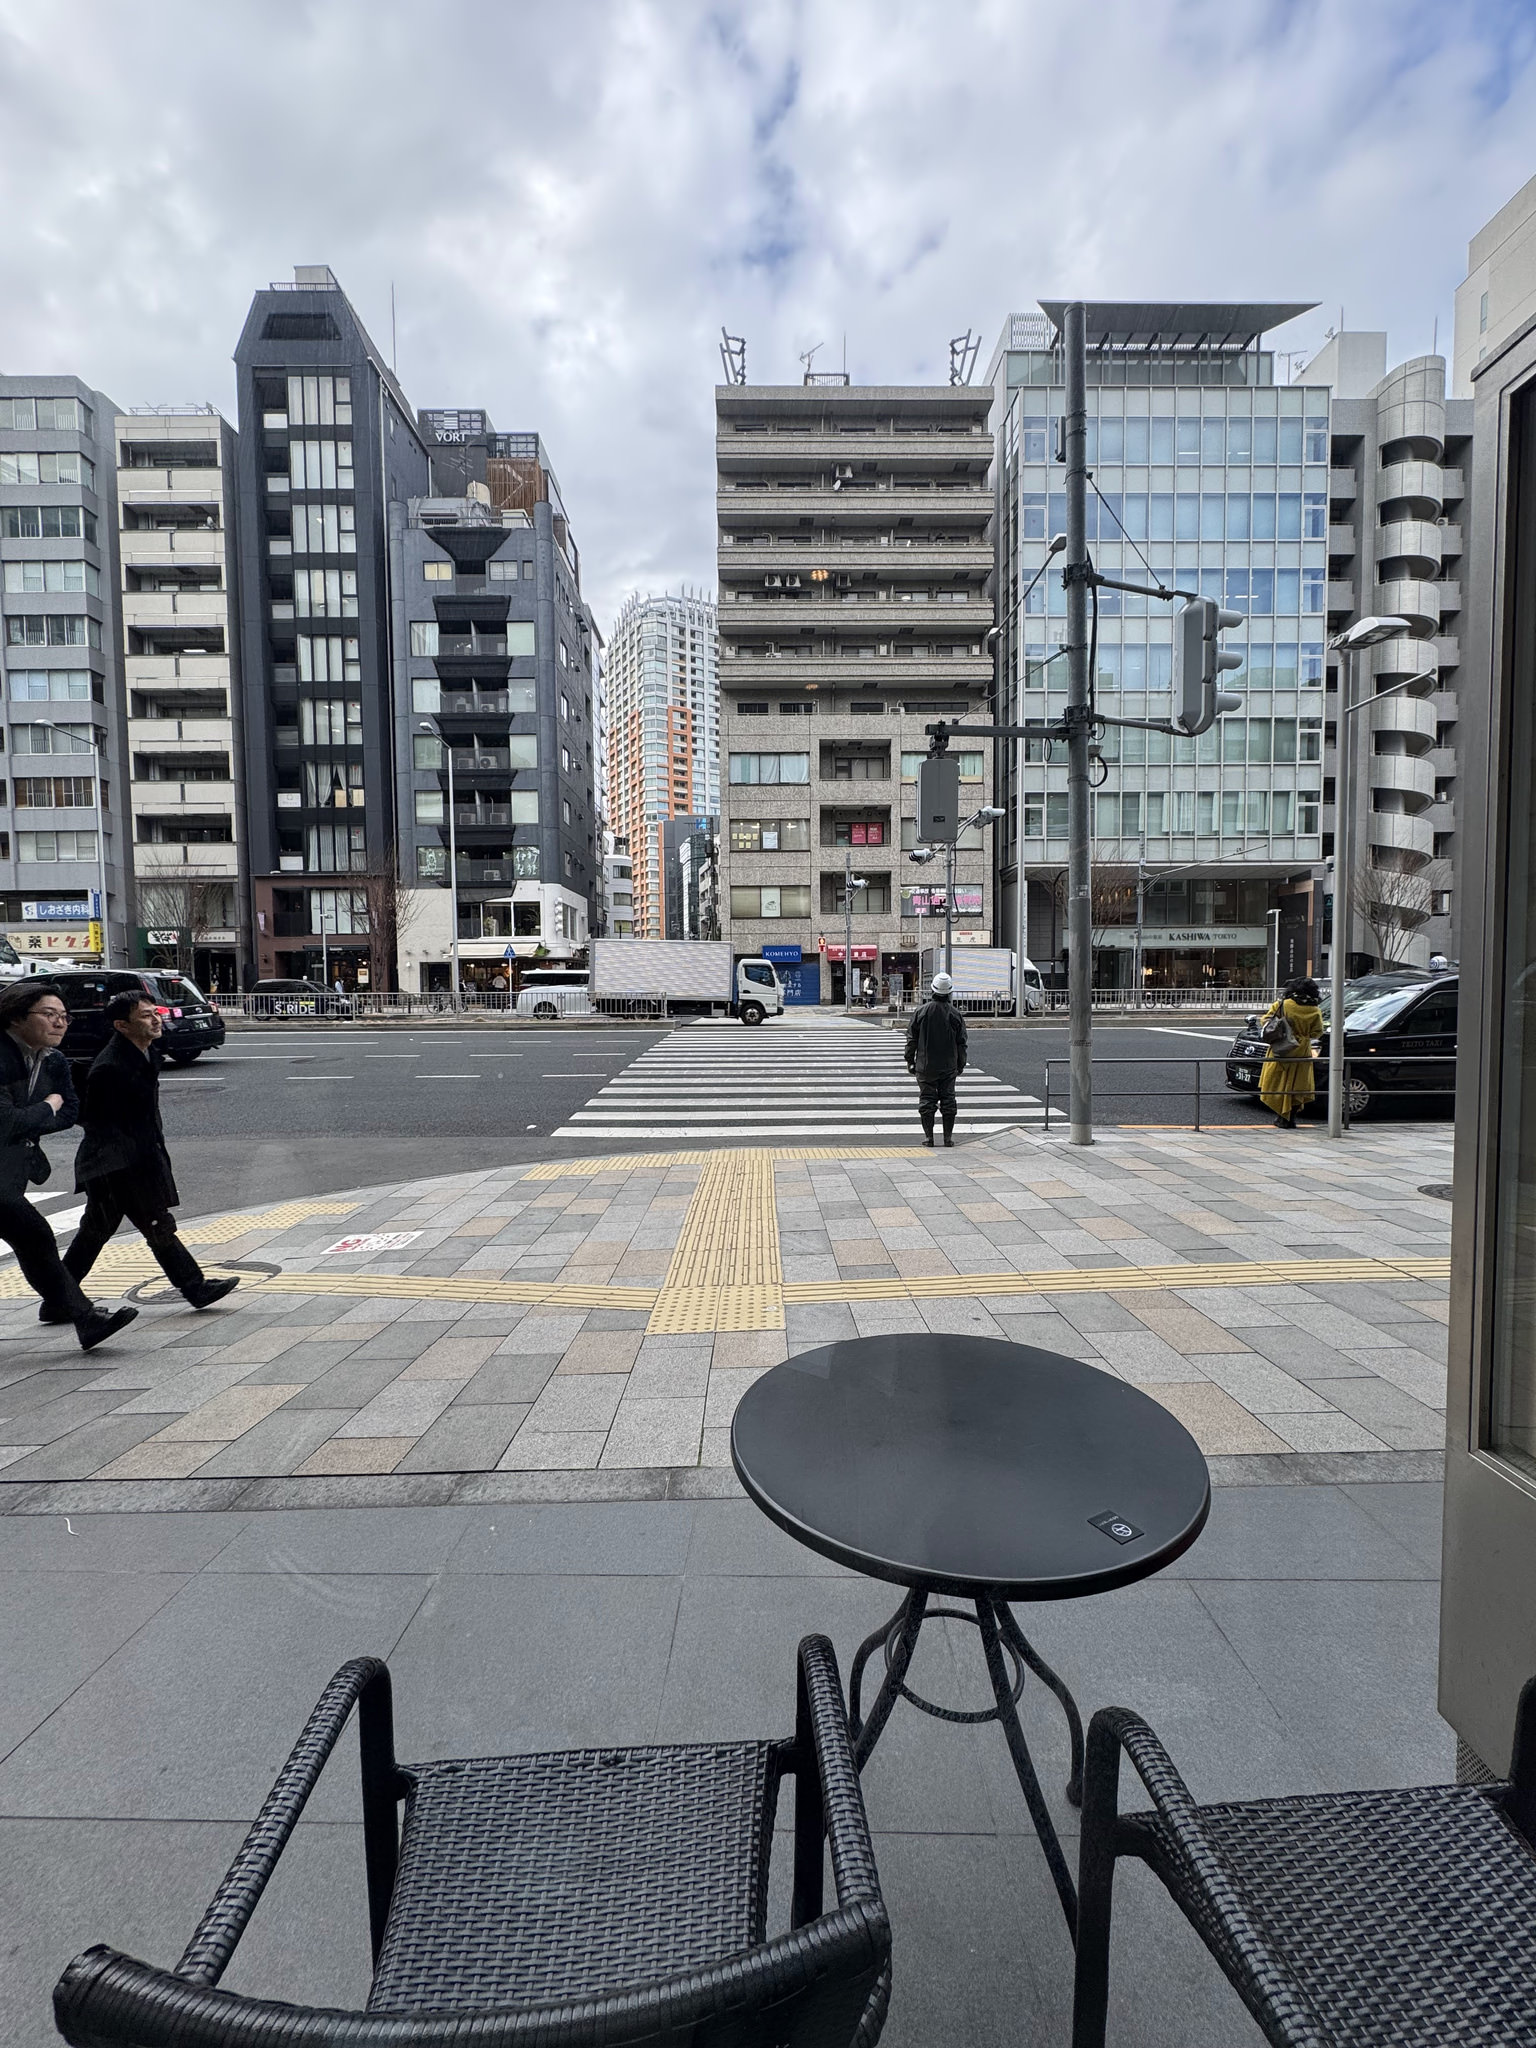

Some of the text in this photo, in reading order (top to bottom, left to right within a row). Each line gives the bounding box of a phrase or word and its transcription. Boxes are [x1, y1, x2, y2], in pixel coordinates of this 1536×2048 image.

[435, 432, 466, 442] VORT
[40, 904, 90, 915] しおざき内科
[1169, 933, 1211, 941] KASHIWA
[275, 1004, 316, 1014] S.RIDE
